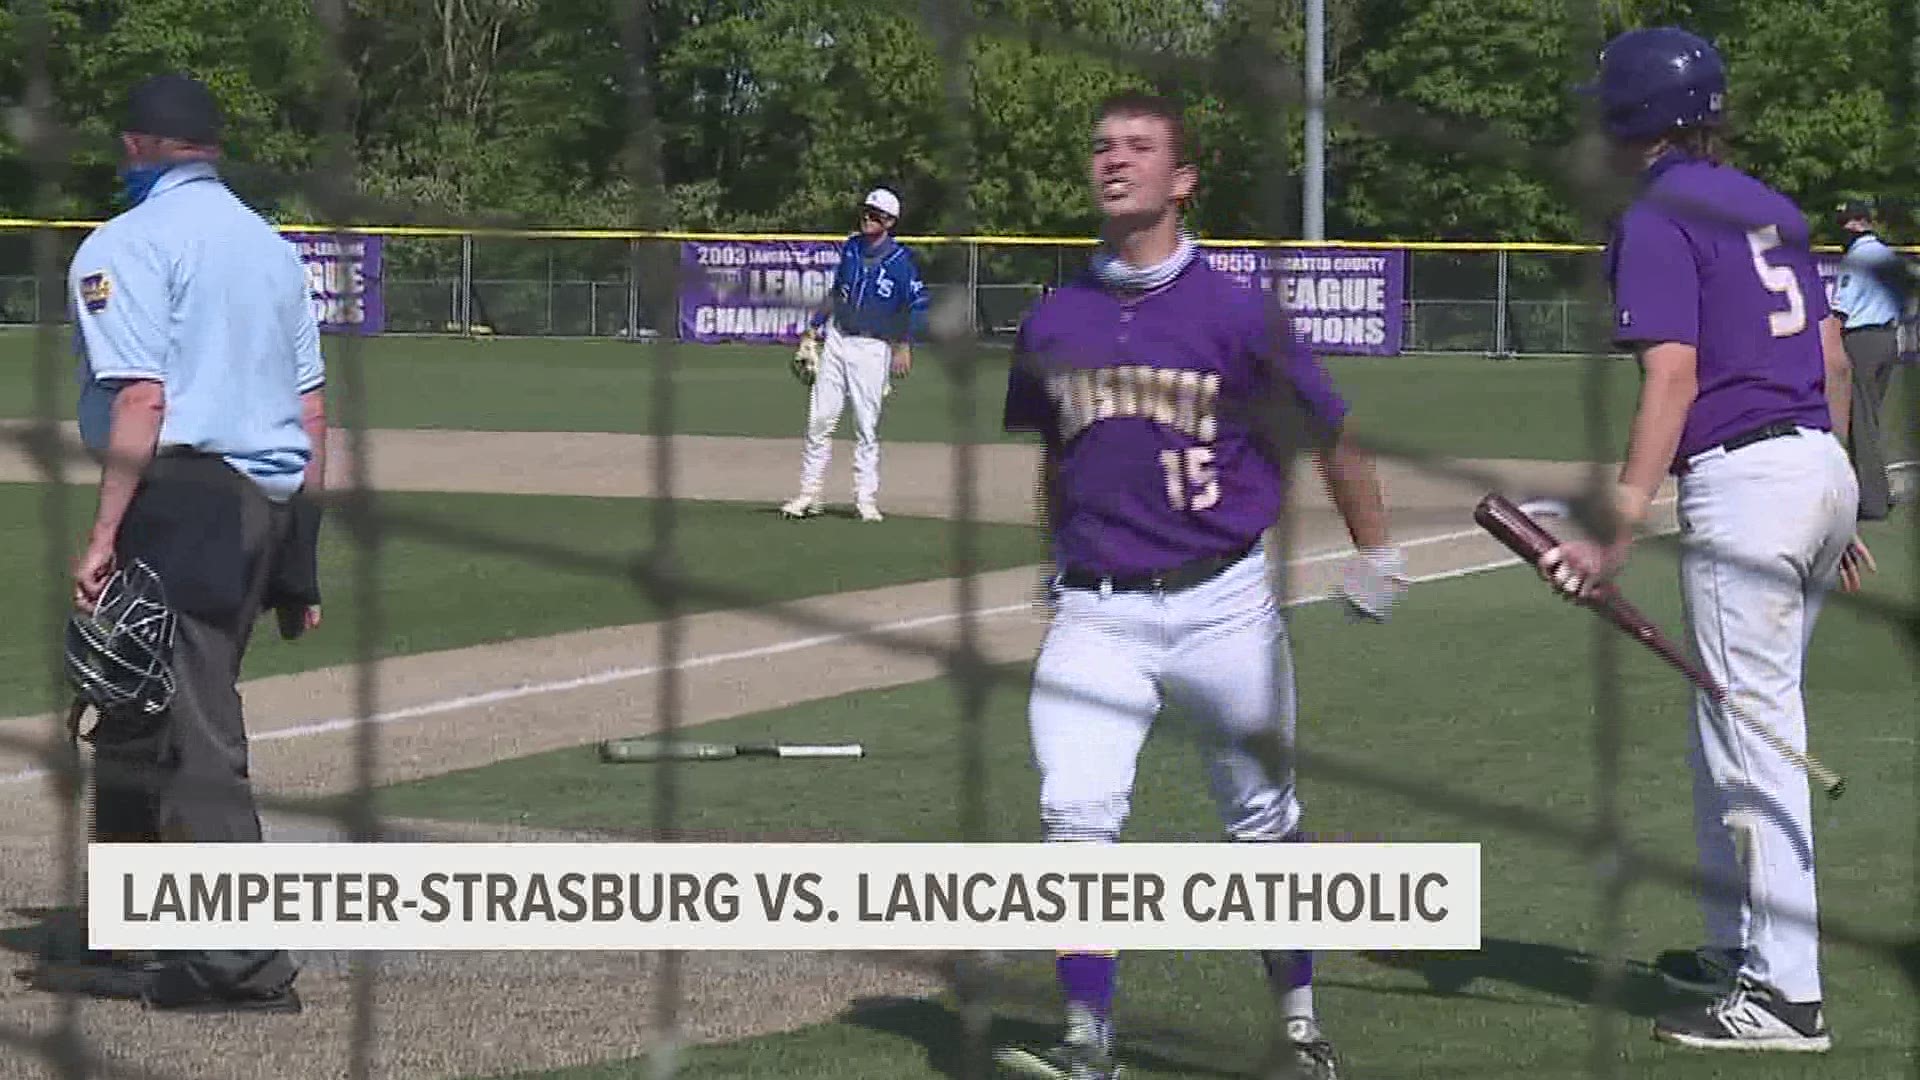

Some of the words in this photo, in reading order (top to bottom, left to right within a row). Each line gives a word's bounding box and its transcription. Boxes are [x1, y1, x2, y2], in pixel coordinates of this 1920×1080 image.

[698, 247, 747, 265] 2003
[1208, 253, 1256, 272] 1955
[1260, 256, 1332, 271] LACASTER
[1334, 256, 1386, 271] COUNTY
[1261, 277, 1386, 311] EAGUE
[1746, 224, 1807, 337] 5
[1158, 447, 1220, 512] 15
